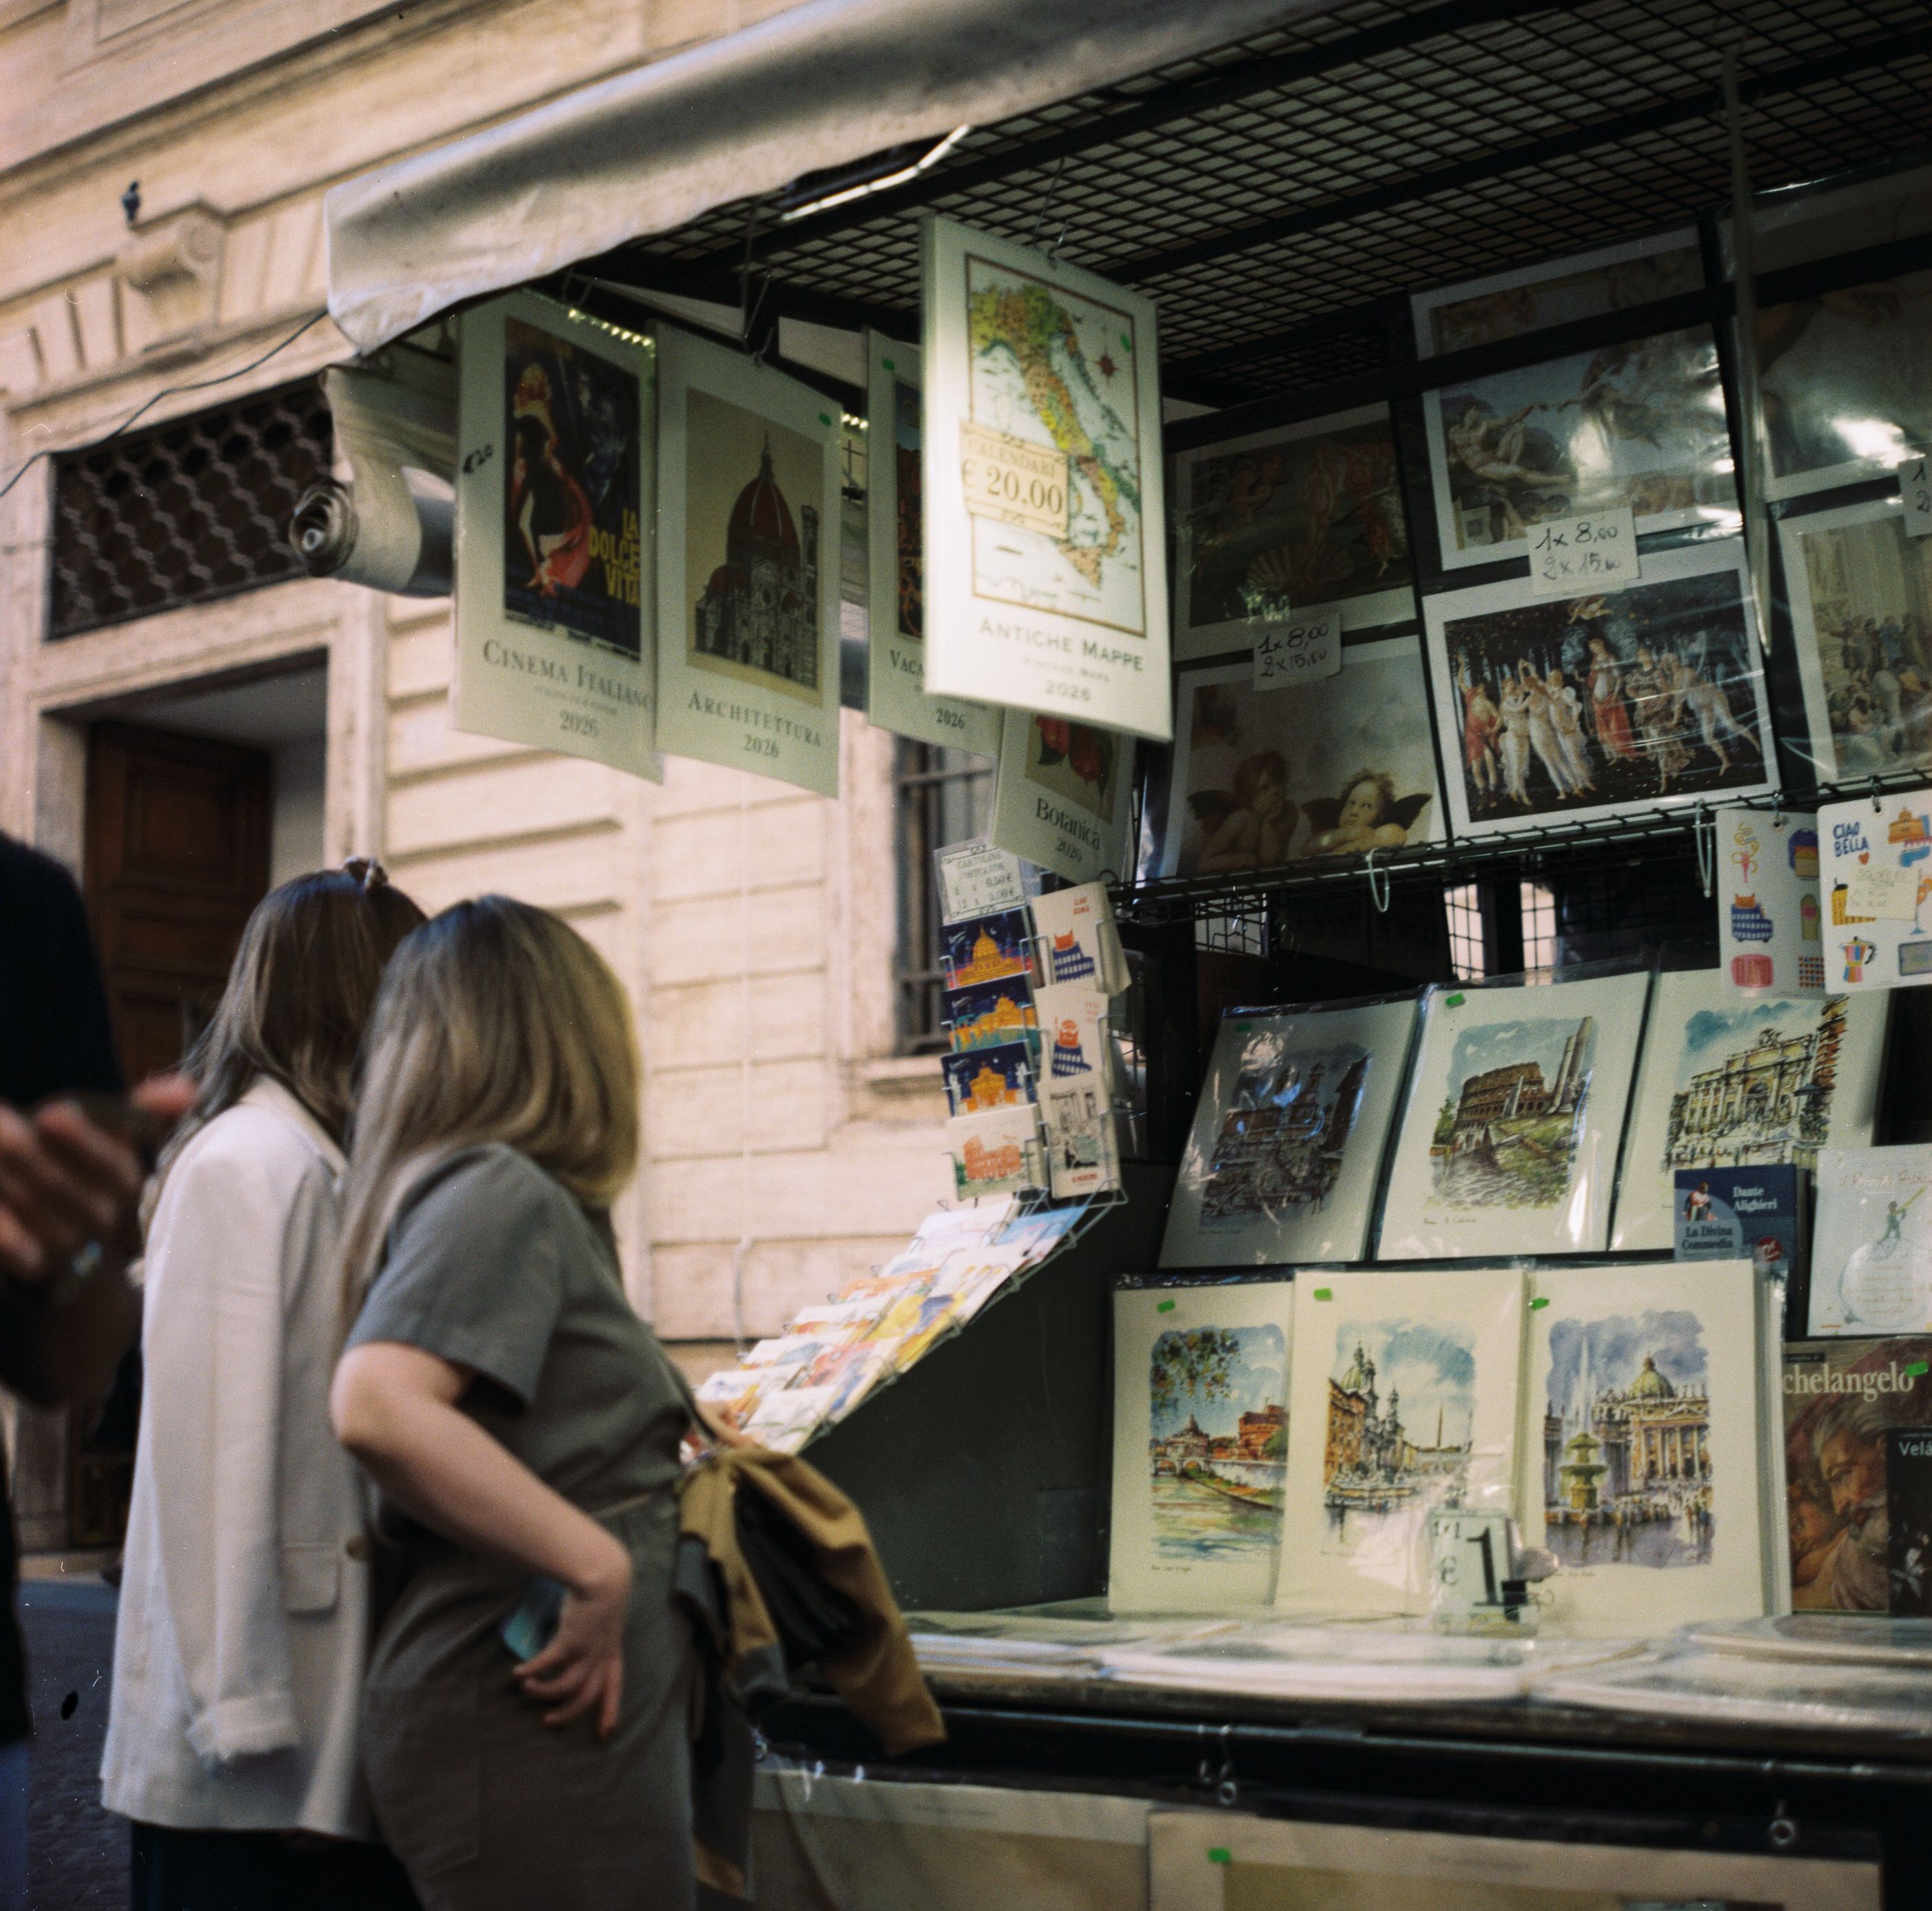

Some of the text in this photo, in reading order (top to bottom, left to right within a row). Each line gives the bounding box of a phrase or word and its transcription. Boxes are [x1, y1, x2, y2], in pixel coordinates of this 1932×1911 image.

[979, 617, 1073, 653] ANTICHE
[1082, 638, 1144, 673] MAPPE
[483, 639, 568, 683] CINEMA
[688, 691, 821, 747] ARCHITETTURA
[936, 708, 965, 729] 2026
[743, 733, 779, 758] 2026
[1036, 797, 1101, 851] Botanica
[1833, 821, 1861, 840] CIAO
[1833, 836, 1870, 858] BELLA
[1732, 1185, 1765, 1198] Dante
[1734, 1198, 1778, 1213] Alighieri
[1685, 1224, 1734, 1238] La Divina
[1681, 1238, 1734, 1250] Commedia
[1782, 1360, 1915, 1402] chelangelo
